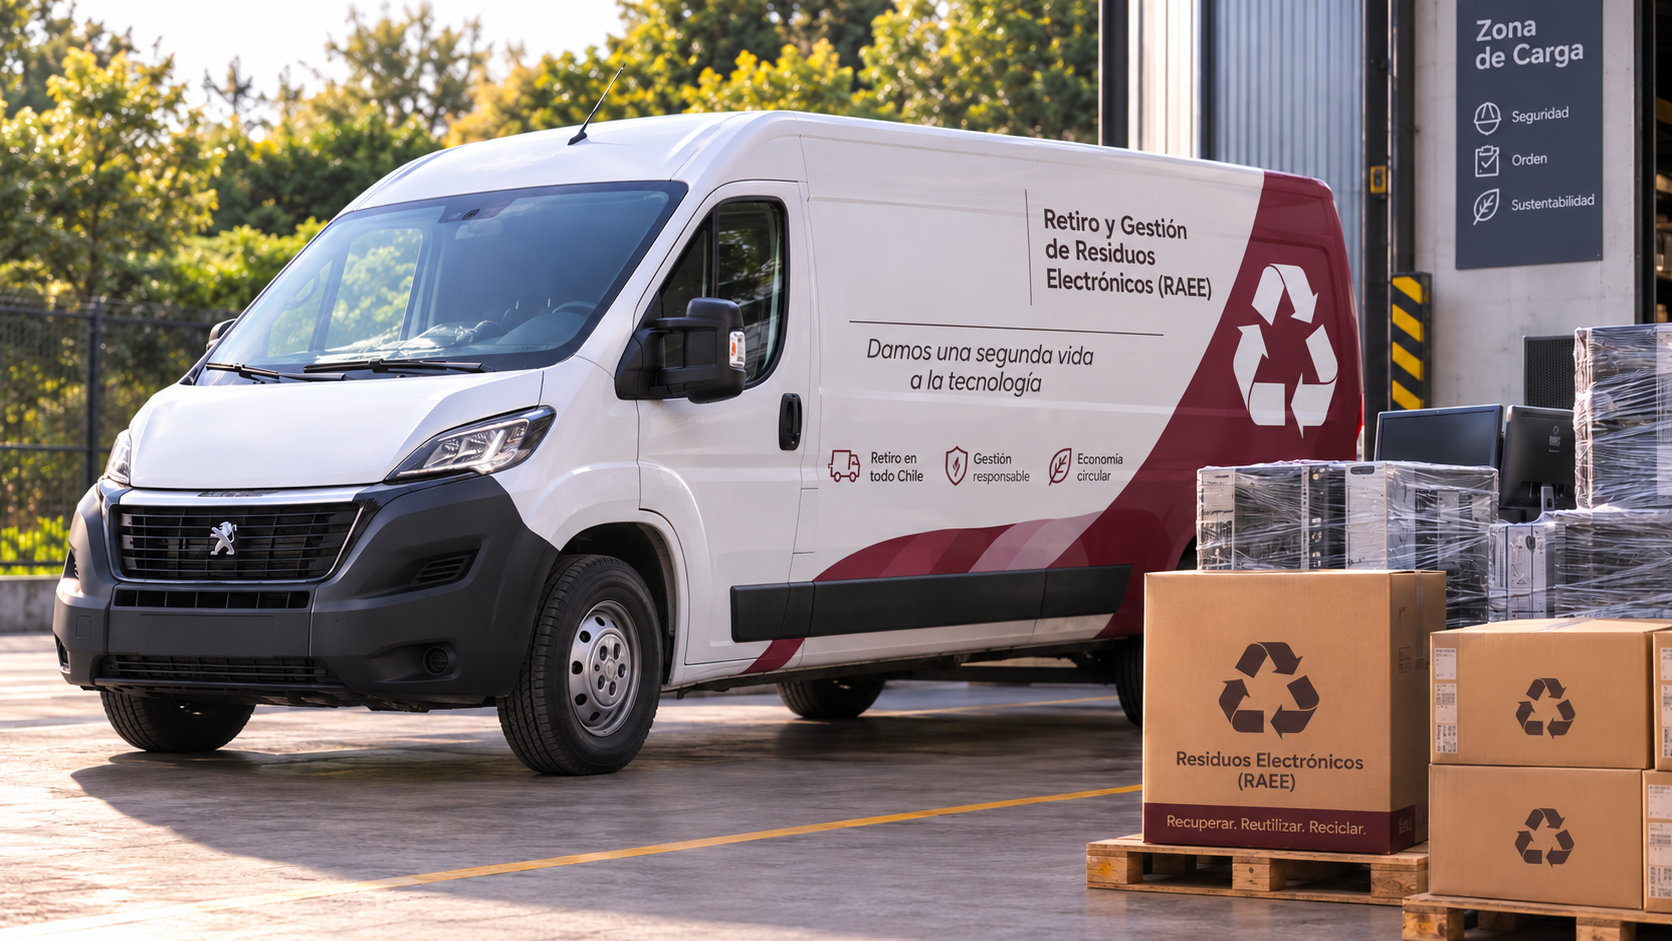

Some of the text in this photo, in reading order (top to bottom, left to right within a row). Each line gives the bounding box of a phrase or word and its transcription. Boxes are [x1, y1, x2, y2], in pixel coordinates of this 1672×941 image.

[1475, 19, 1537, 41] Zona
[1475, 44, 1584, 69] de Carga
[1511, 106, 1569, 125] Seguridad
[1511, 152, 1548, 167] Orden
[1511, 194, 1595, 212] Sustentabilidad
[1043, 209, 1188, 240] Retiro y Gestión
[1045, 238, 1156, 266] de Residuos
[1046, 268, 1212, 301] Electrónicos (RAEE)
[866, 339, 1094, 368] Damos una segunda vida
[910, 370, 1042, 397] a la tecnología
[870, 451, 917, 465] Retiro en
[973, 452, 1012, 465] Gestión
[869, 468, 924, 483] todo Chile
[972, 469, 1031, 485] responsable
[1076, 469, 1112, 482] circular
[1176, 751, 1364, 770] Residuos Electrónicos
[1237, 773, 1296, 793] (RAEE)
[1166, 815, 1367, 835] Recuperar. Reutilizar. Reciclar.
